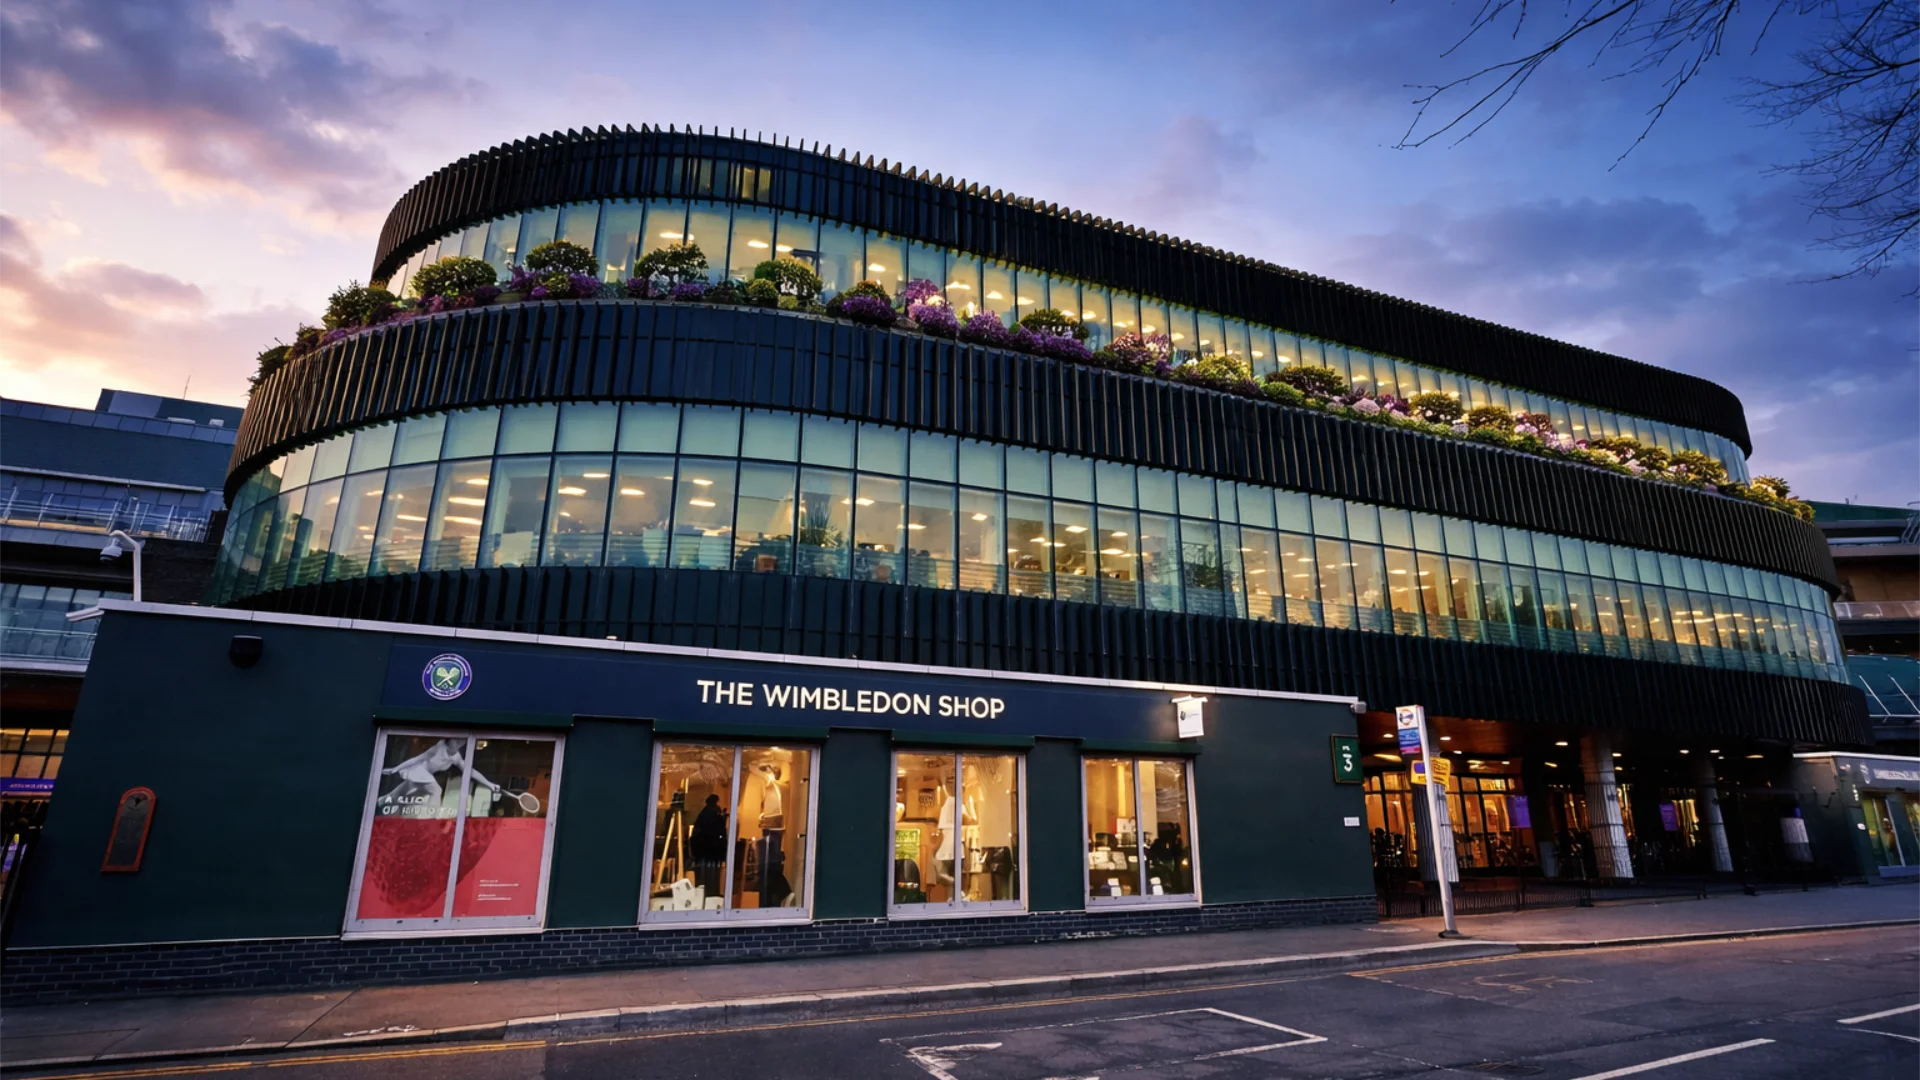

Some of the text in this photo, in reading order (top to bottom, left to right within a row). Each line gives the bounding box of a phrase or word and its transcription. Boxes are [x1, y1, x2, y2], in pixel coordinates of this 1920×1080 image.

[697, 679, 1005, 720] THE WIMBLEDON SHOP
[1342, 753, 1353, 772] 3
[384, 796, 392, 804] A
